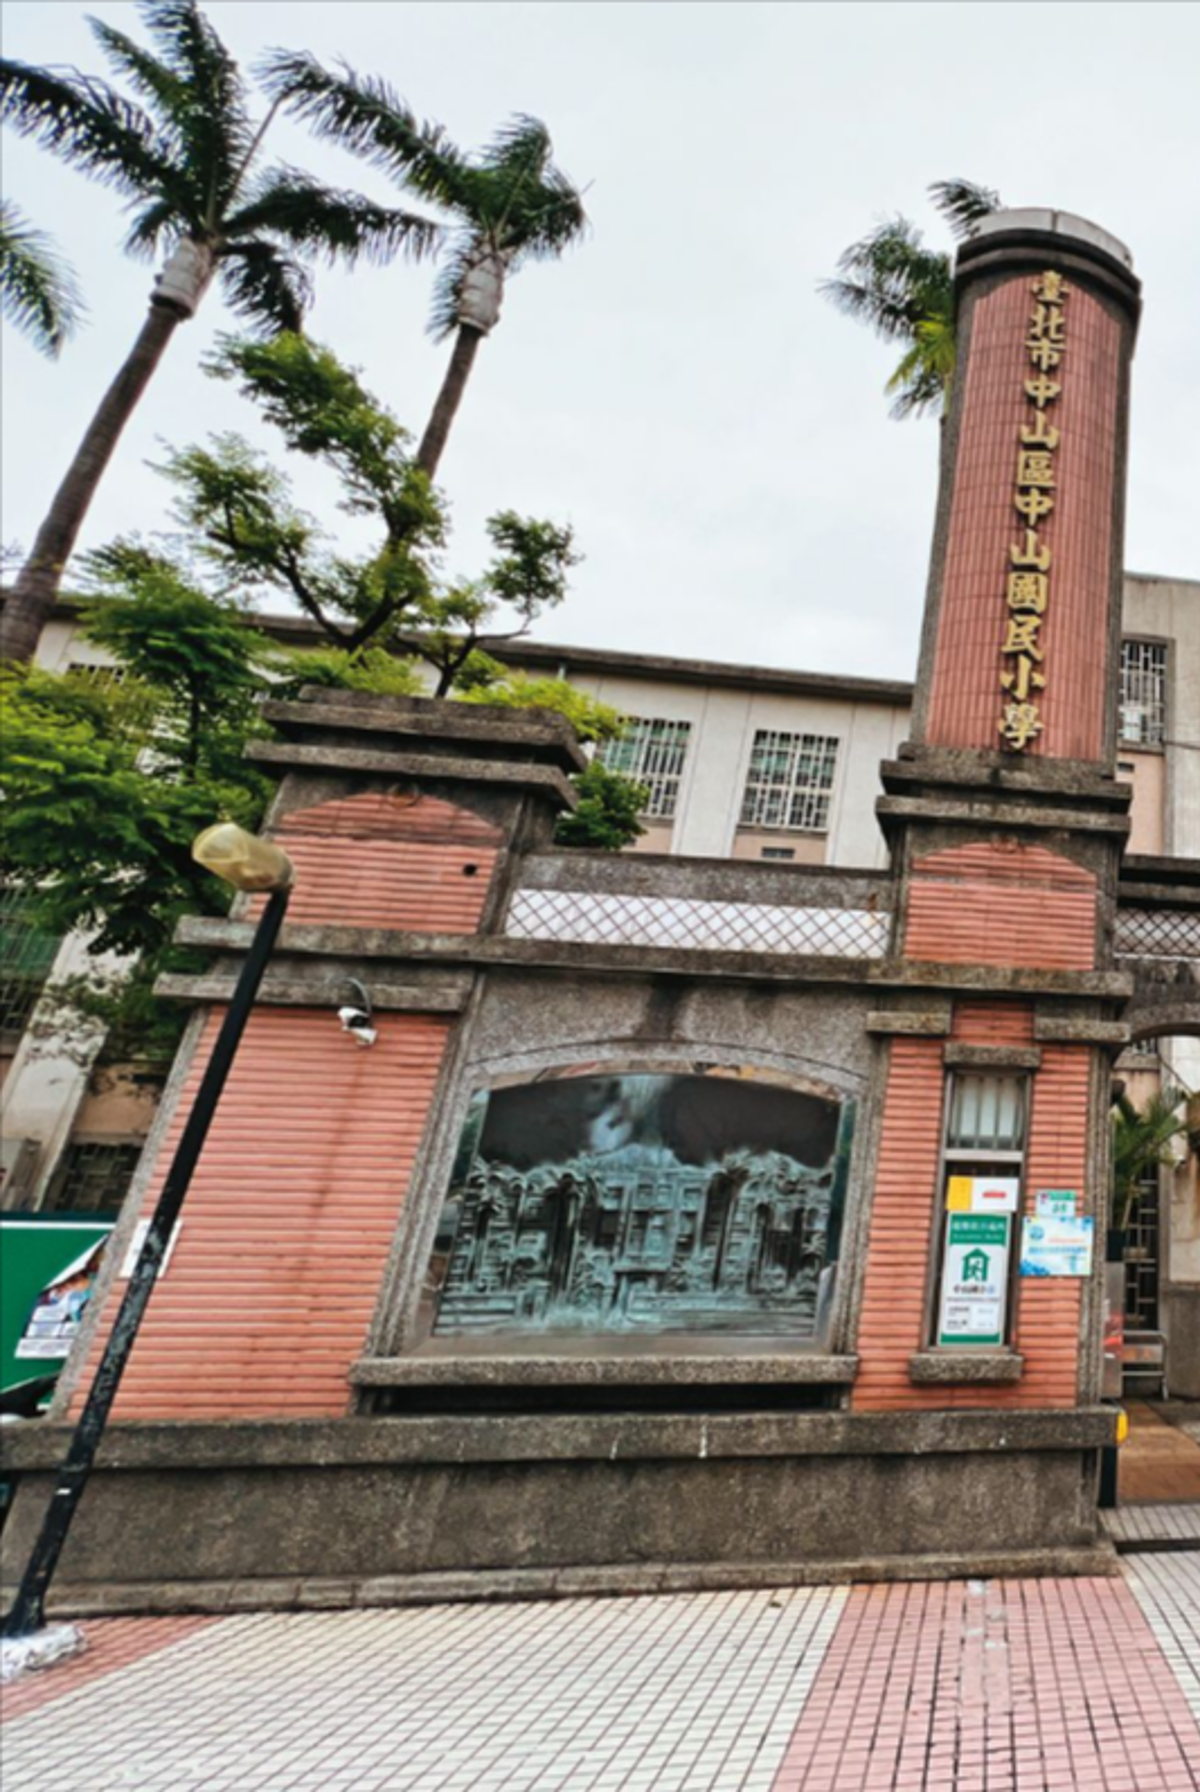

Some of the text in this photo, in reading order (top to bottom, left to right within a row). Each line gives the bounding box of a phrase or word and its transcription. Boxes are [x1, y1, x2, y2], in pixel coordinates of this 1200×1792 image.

[999, 270, 1066, 750] 臺北市中山區中山國民小學
